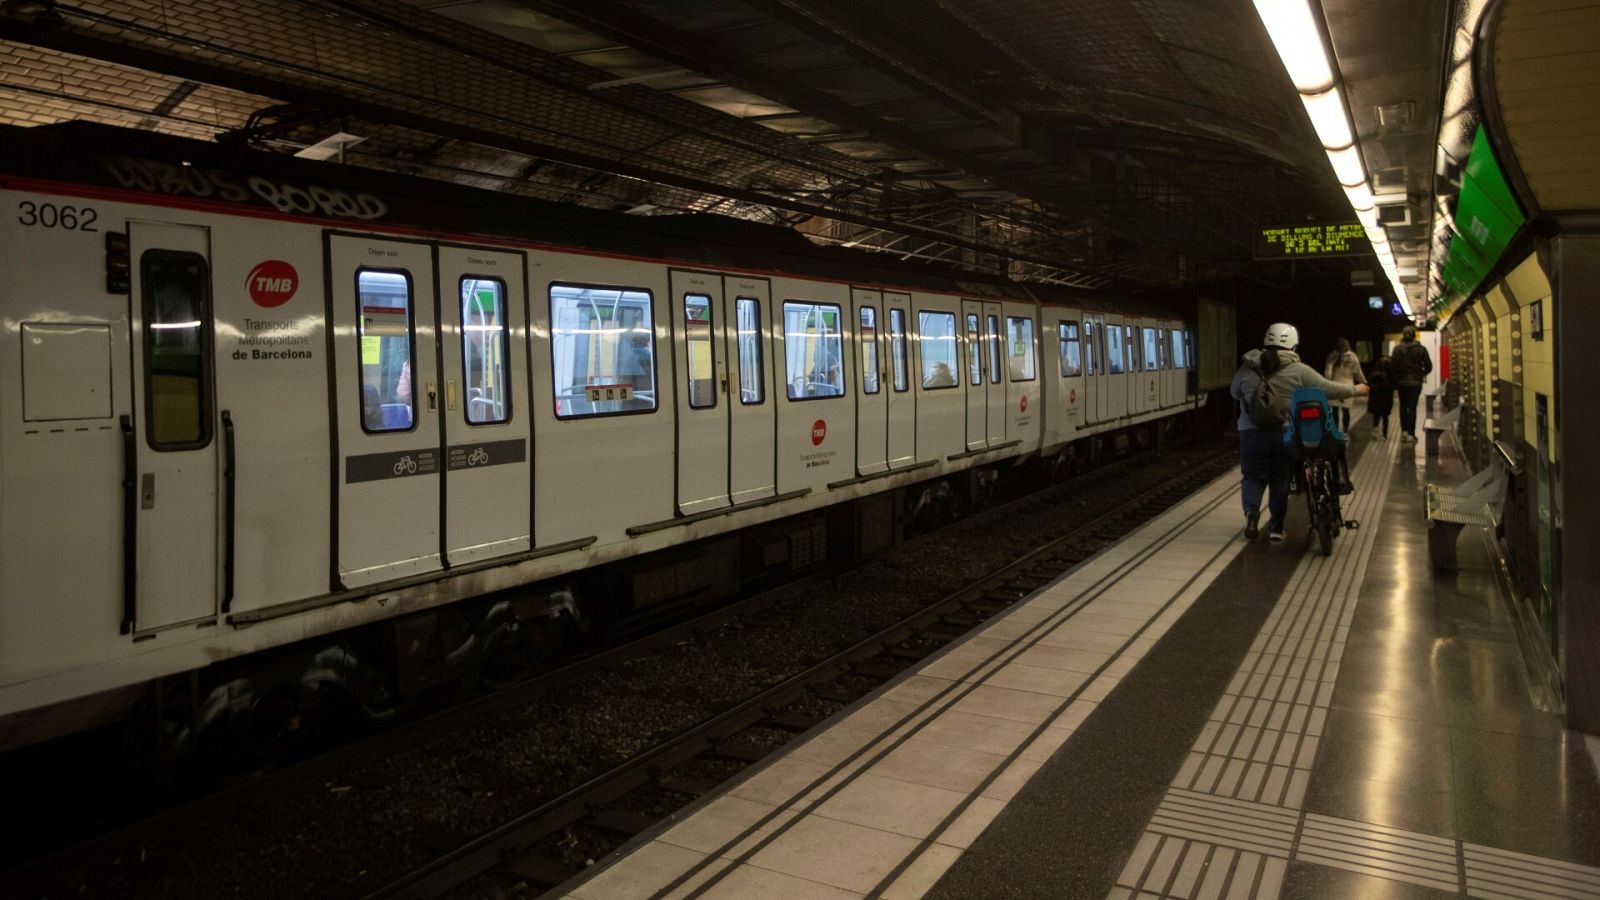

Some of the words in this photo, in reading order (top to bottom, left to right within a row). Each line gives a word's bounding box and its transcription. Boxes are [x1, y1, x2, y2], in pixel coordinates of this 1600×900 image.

[18, 201, 98, 232] 3062
[256, 277, 292, 292] TMB
[243, 318, 299, 332] Transports
[238, 335, 309, 348] Metropolitans
[232, 349, 248, 360] de
[252, 349, 313, 360] Barcelona
